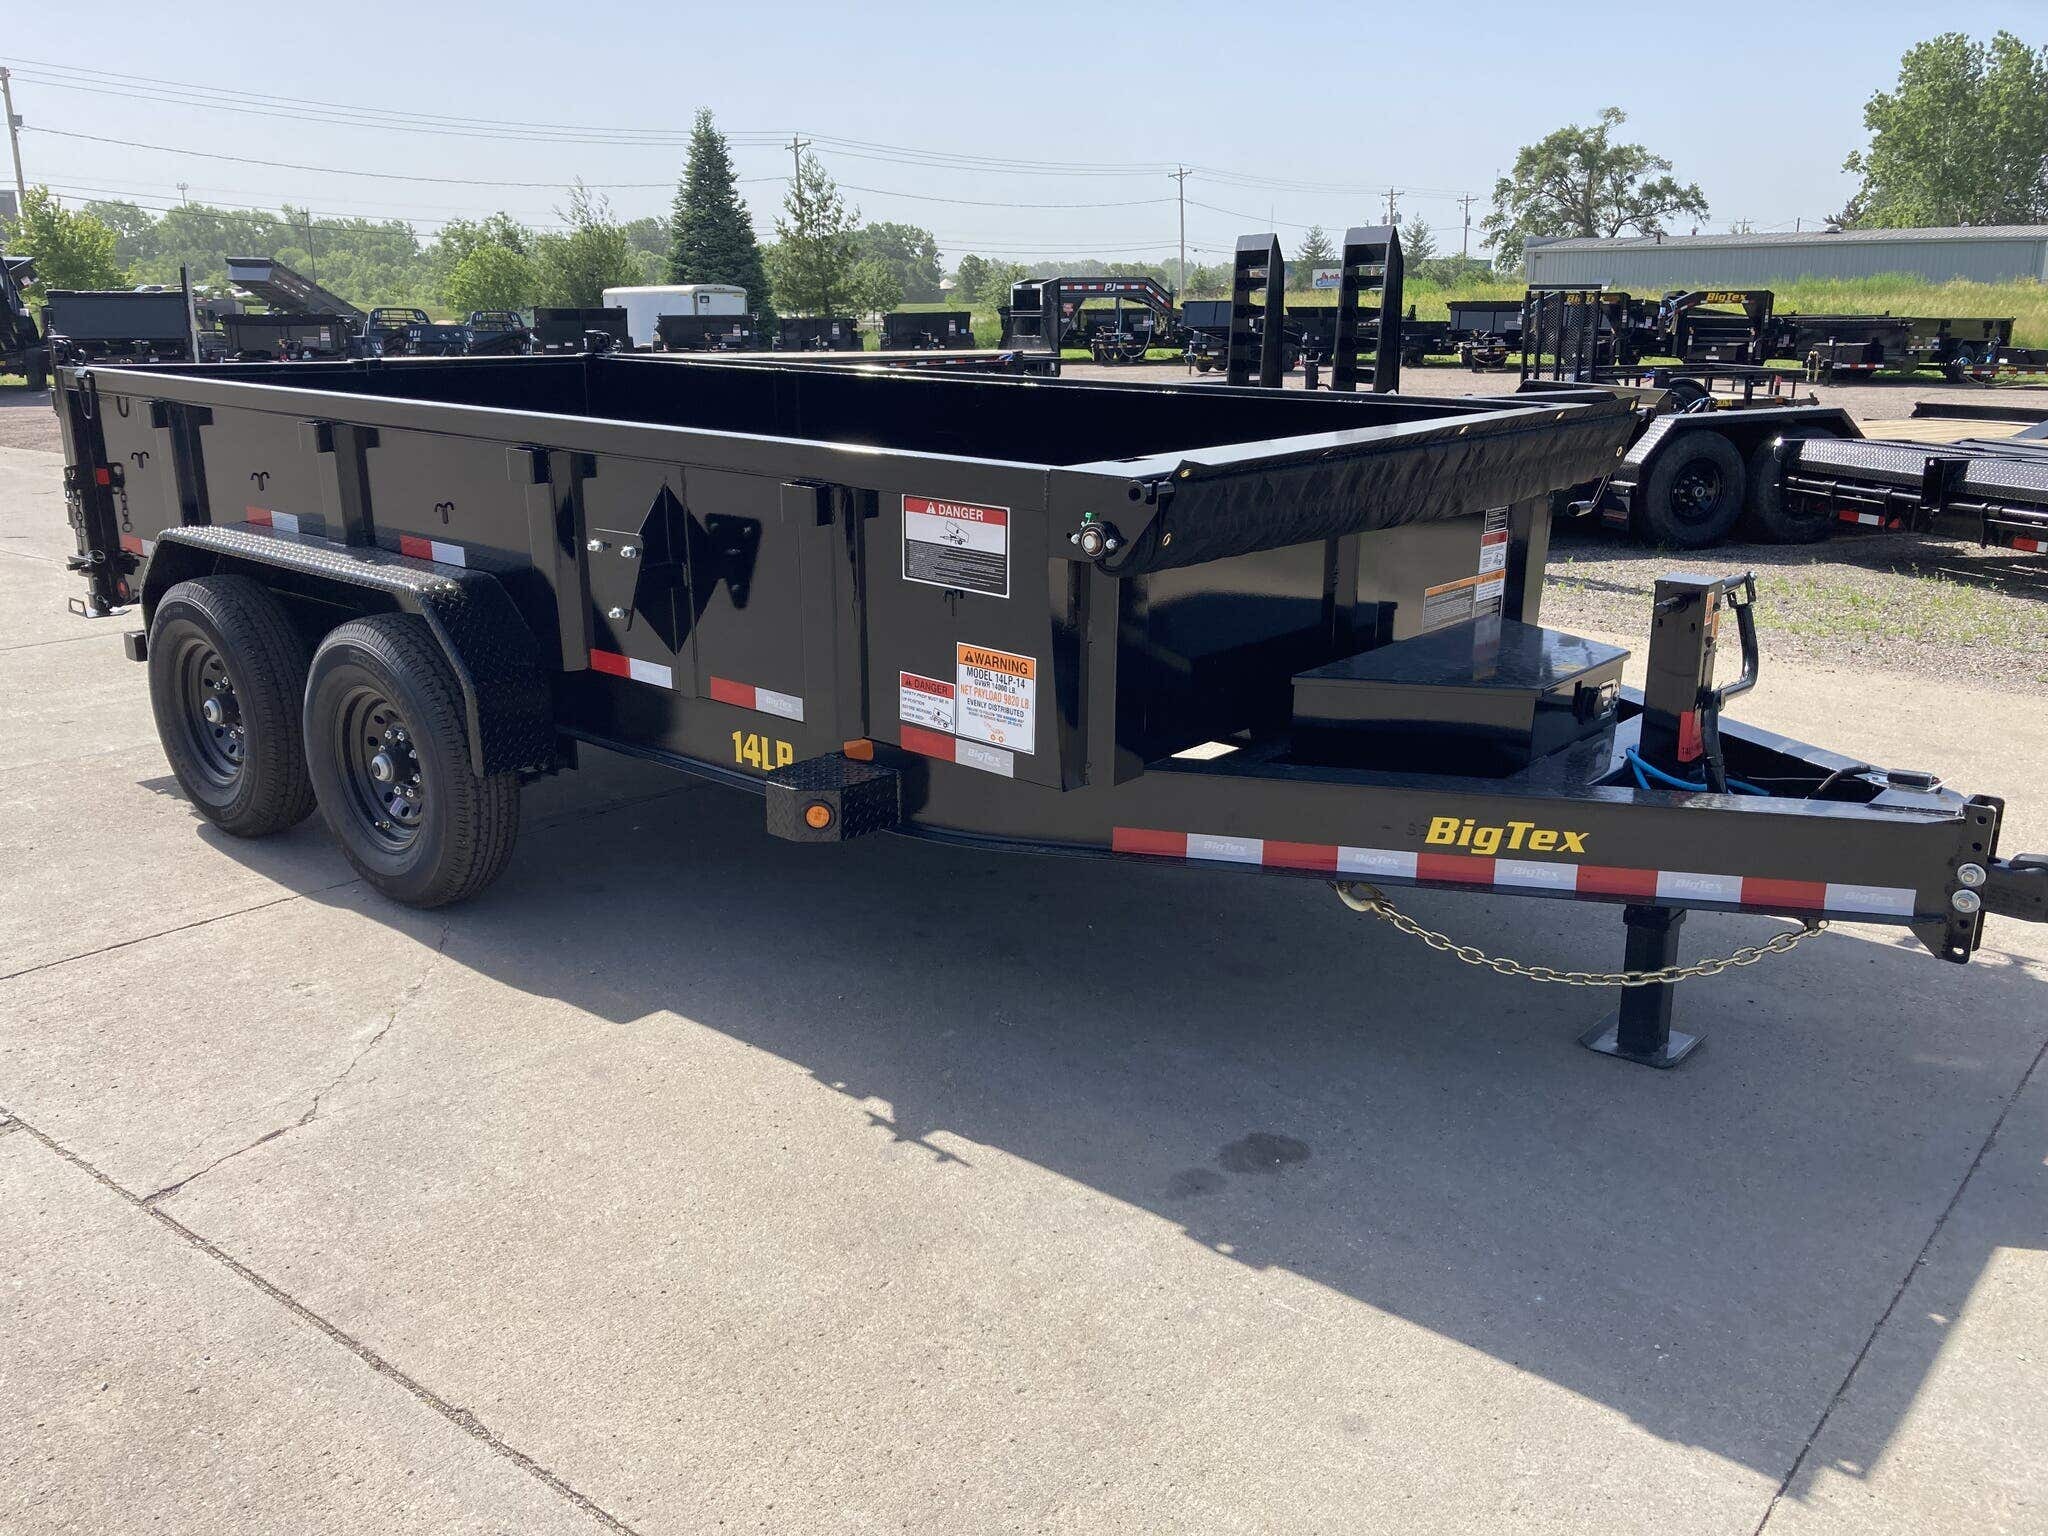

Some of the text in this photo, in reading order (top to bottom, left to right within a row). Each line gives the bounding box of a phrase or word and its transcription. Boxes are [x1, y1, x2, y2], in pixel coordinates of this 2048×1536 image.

[1104, 283, 1117, 291] PJ
[1706, 292, 1747, 303] BigTex
[938, 503, 984, 522] DANGER
[974, 653, 1028, 675] WARNING
[914, 679, 948, 695] DANGER
[966, 667, 1025, 688] MODEL 14LP-14
[975, 679, 990, 688] GVWR
[961, 683, 972, 695] NET
[974, 686, 1001, 703] PAYLOAD
[1020, 698, 1029, 709] LB
[967, 698, 987, 709] EVENLY
[988, 703, 1025, 718] DISTRIBUTED
[732, 730, 794, 771] 14LP
[967, 748, 1001, 762] BigTex
[1424, 816, 1590, 855] BigTex
[1512, 866, 1561, 881] BigTex
